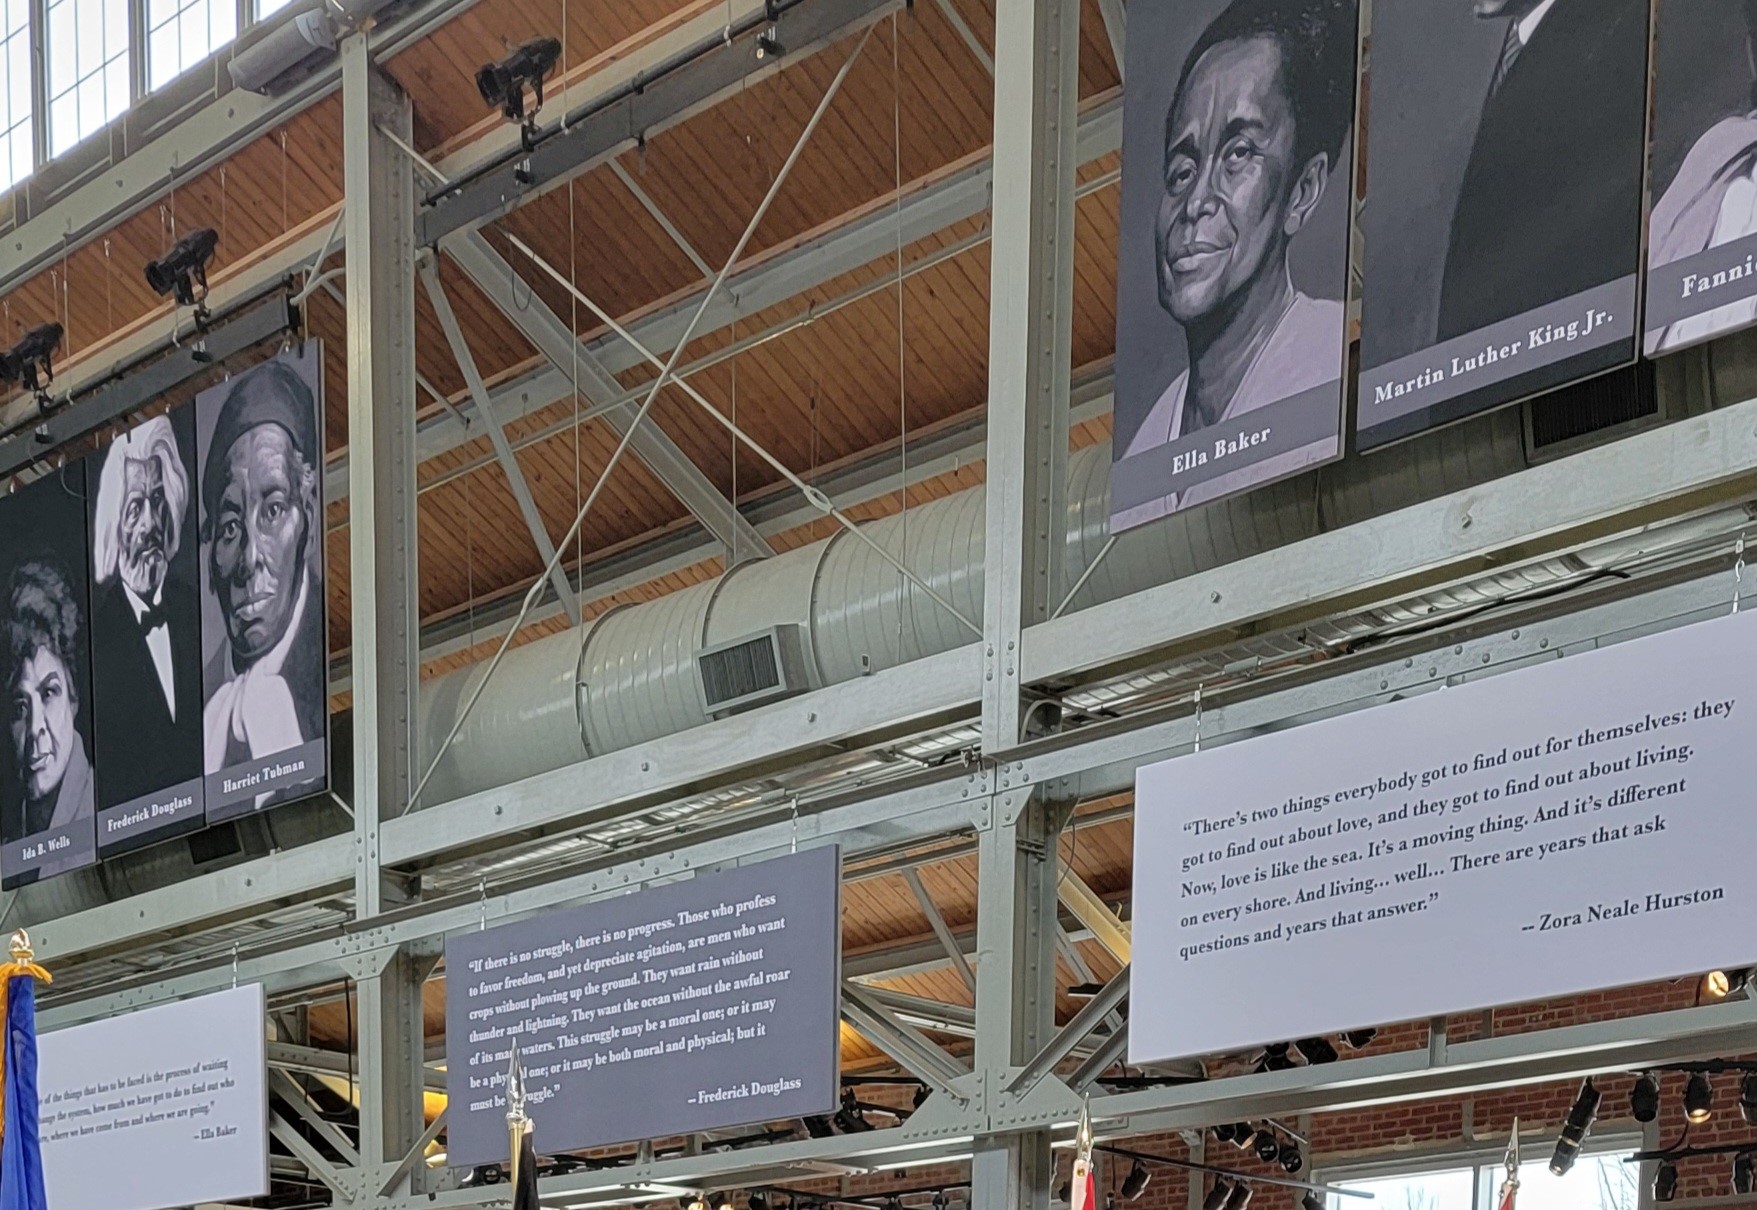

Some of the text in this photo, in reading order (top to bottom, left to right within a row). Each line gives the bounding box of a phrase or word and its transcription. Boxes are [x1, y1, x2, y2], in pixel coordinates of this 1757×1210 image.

[1681, 254, 1757, 299] Fanni
[1374, 309, 1612, 404] Martin Luther King Jr.
[1172, 428, 1270, 475] Ella Baker
[223, 760, 304, 793] Harriet Tubman
[1183, 699, 1735, 835] “There’s two things everybody got to find out for themselves: they
[107, 796, 192, 832] Frederick Douglass
[1181, 778, 1685, 897] Now, love is like the sea. It’s a moving thing. And it’s different
[1182, 744, 1693, 872] got to find out about love, and they got to find out about living.
[22, 835, 70, 860] Ida B. Wells
[1180, 814, 1665, 927] on every shore. And living... well... There are years that ask
[484, 957, 508, 970] there
[509, 951, 518, 964] is
[519, 952, 531, 962] no
[575, 935, 600, 949] there
[602, 930, 611, 943] is
[613, 930, 626, 940] no
[677, 910, 709, 925] Those
[711, 903, 733, 917] who
[735, 894, 776, 917] profess
[1179, 891, 1438, 961] questions and years that answer.”
[1539, 887, 1723, 931] Zora Neale Hurston
[469, 987, 478, 997] to
[479, 981, 503, 994] favor
[547, 963, 565, 979] and
[567, 962, 581, 979] yet
[583, 951, 635, 973] depreciate
[688, 937, 705, 948] are
[707, 931, 731, 944] men
[732, 923, 755, 938] who
[757, 917, 785, 933] want
[469, 1007, 493, 1020] crops
[494, 998, 529, 1014] without
[531, 989, 568, 1010] plowing
[569, 988, 582, 1001] up
[584, 982, 600, 995] the
[642, 968, 668, 983] They
[669, 962, 695, 977] want
[697, 959, 720, 971] rain
[721, 948, 763, 966] without
[469, 1026, 505, 1042] thunder
[506, 1020, 524, 1035] and
[570, 1008, 595, 1022] They
[596, 1002, 621, 1016] want
[623, 998, 639, 1011] the
[640, 994, 670, 1008] ocean
[672, 984, 712, 1001] without
[714, 979, 731, 993] the
[733, 971, 763, 989] awful
[765, 970, 790, 983] roar
[469, 1052, 480, 1065] of
[481, 1051, 493, 1063] its
[556, 1033, 579, 1048] This
[580, 1025, 620, 1044] struggle
[621, 1024, 643, 1037] may
[645, 1018, 658, 1031] be
[659, 1020, 666, 1029] a
[668, 1009, 700, 1027] moral
[726, 1005, 739, 1016] or
[741, 1002, 749, 1013] it
[751, 998, 776, 1012] may
[698, 1077, 801, 1104] Frederick Douglass
[200, 1125, 237, 1139] Ella Baker
